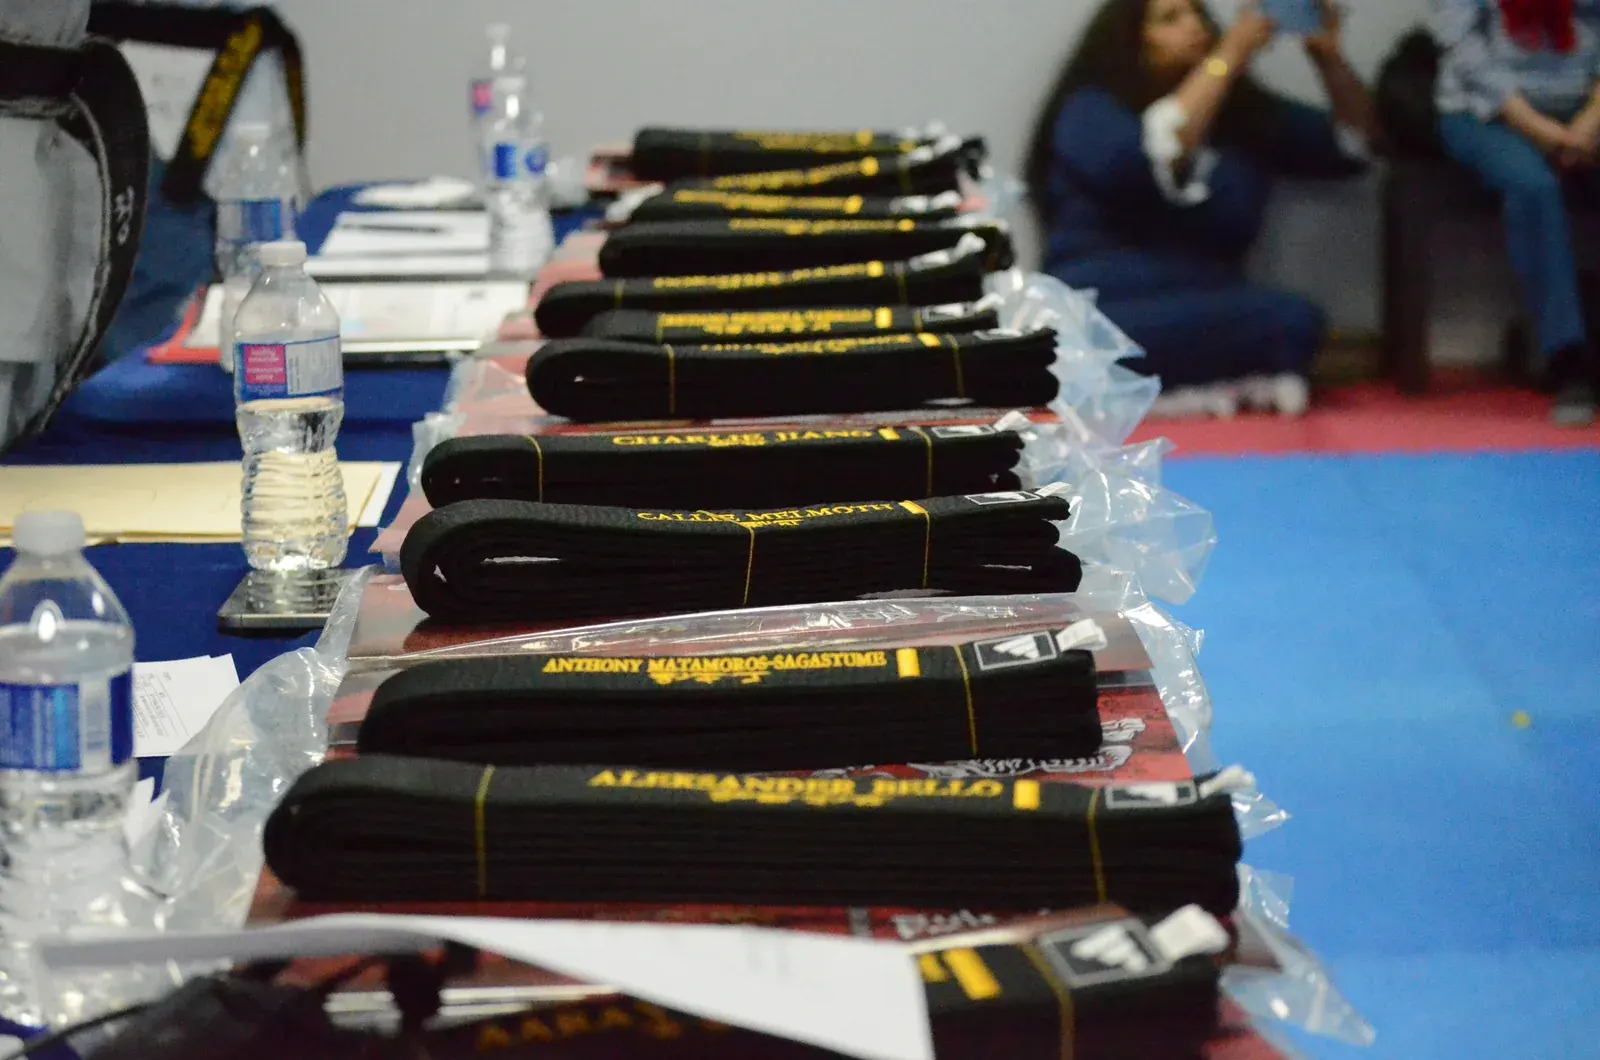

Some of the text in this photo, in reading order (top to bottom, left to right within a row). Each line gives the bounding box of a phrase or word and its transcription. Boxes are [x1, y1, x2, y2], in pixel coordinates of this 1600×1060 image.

[637, 512, 740, 522] CALLIE
[541, 651, 887, 674] ANTHONY MATAMOROS-SAGASTUME
[588, 768, 1004, 797] ALEKSANDER BELLO
